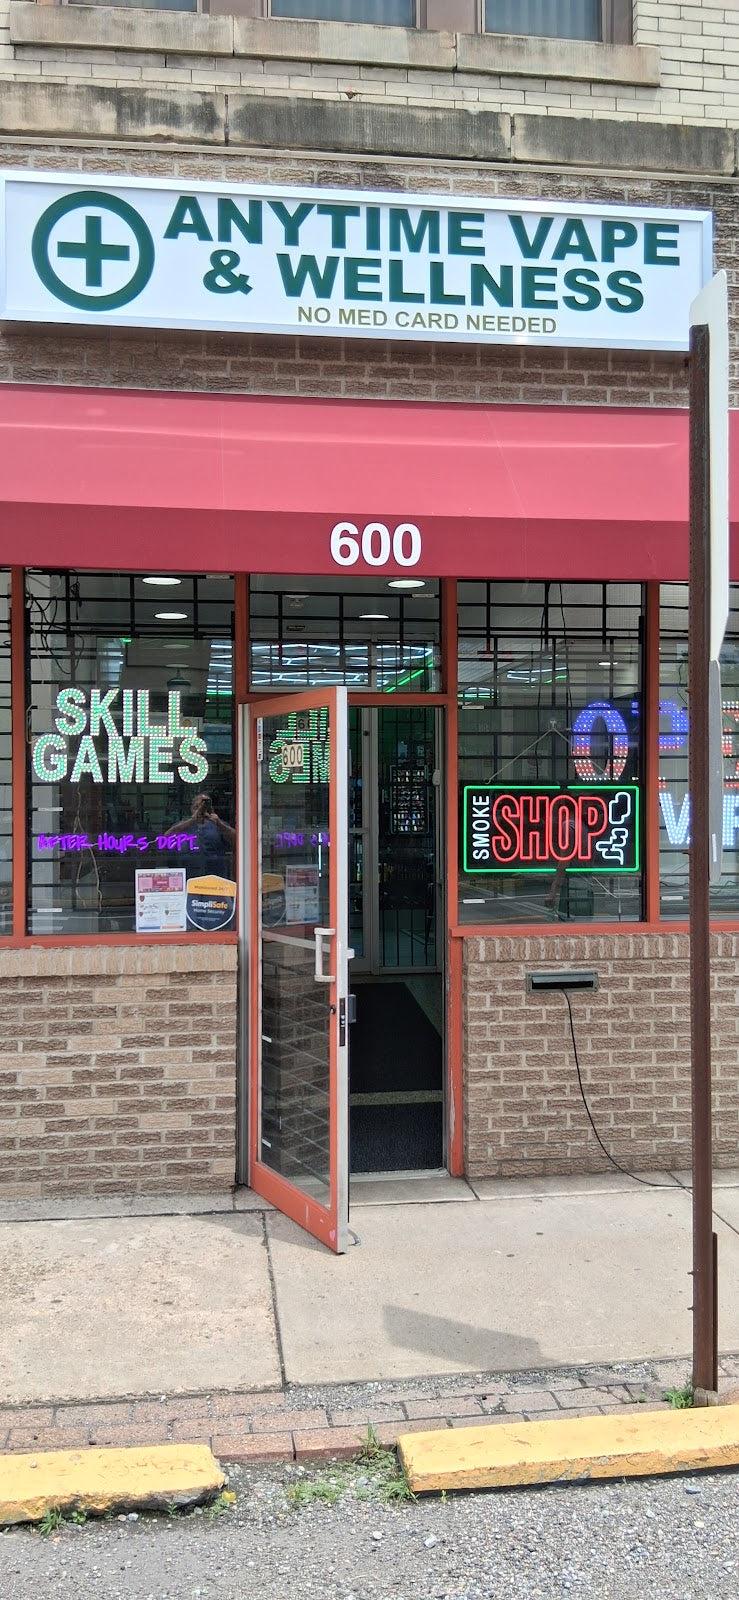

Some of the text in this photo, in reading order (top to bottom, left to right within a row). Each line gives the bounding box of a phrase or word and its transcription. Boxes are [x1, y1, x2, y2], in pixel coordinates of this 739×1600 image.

[163, 195, 680, 266] ANYTIME VAPE
[202, 249, 644, 313] & WELLNESS
[297, 306, 557, 333] NO MED CARD NEEDED
[330, 522, 422, 567] 600
[55, 687, 198, 738] SKILL
[32, 734, 209, 784] GAMES
[282, 745, 303, 766] 600
[38, 833, 93, 851] AFTER
[97, 832, 149, 853] HOURS
[472, 795, 490, 860] SMOKE
[492, 794, 608, 862] SHOP
[191, 899, 228, 909] SimpliSafe
